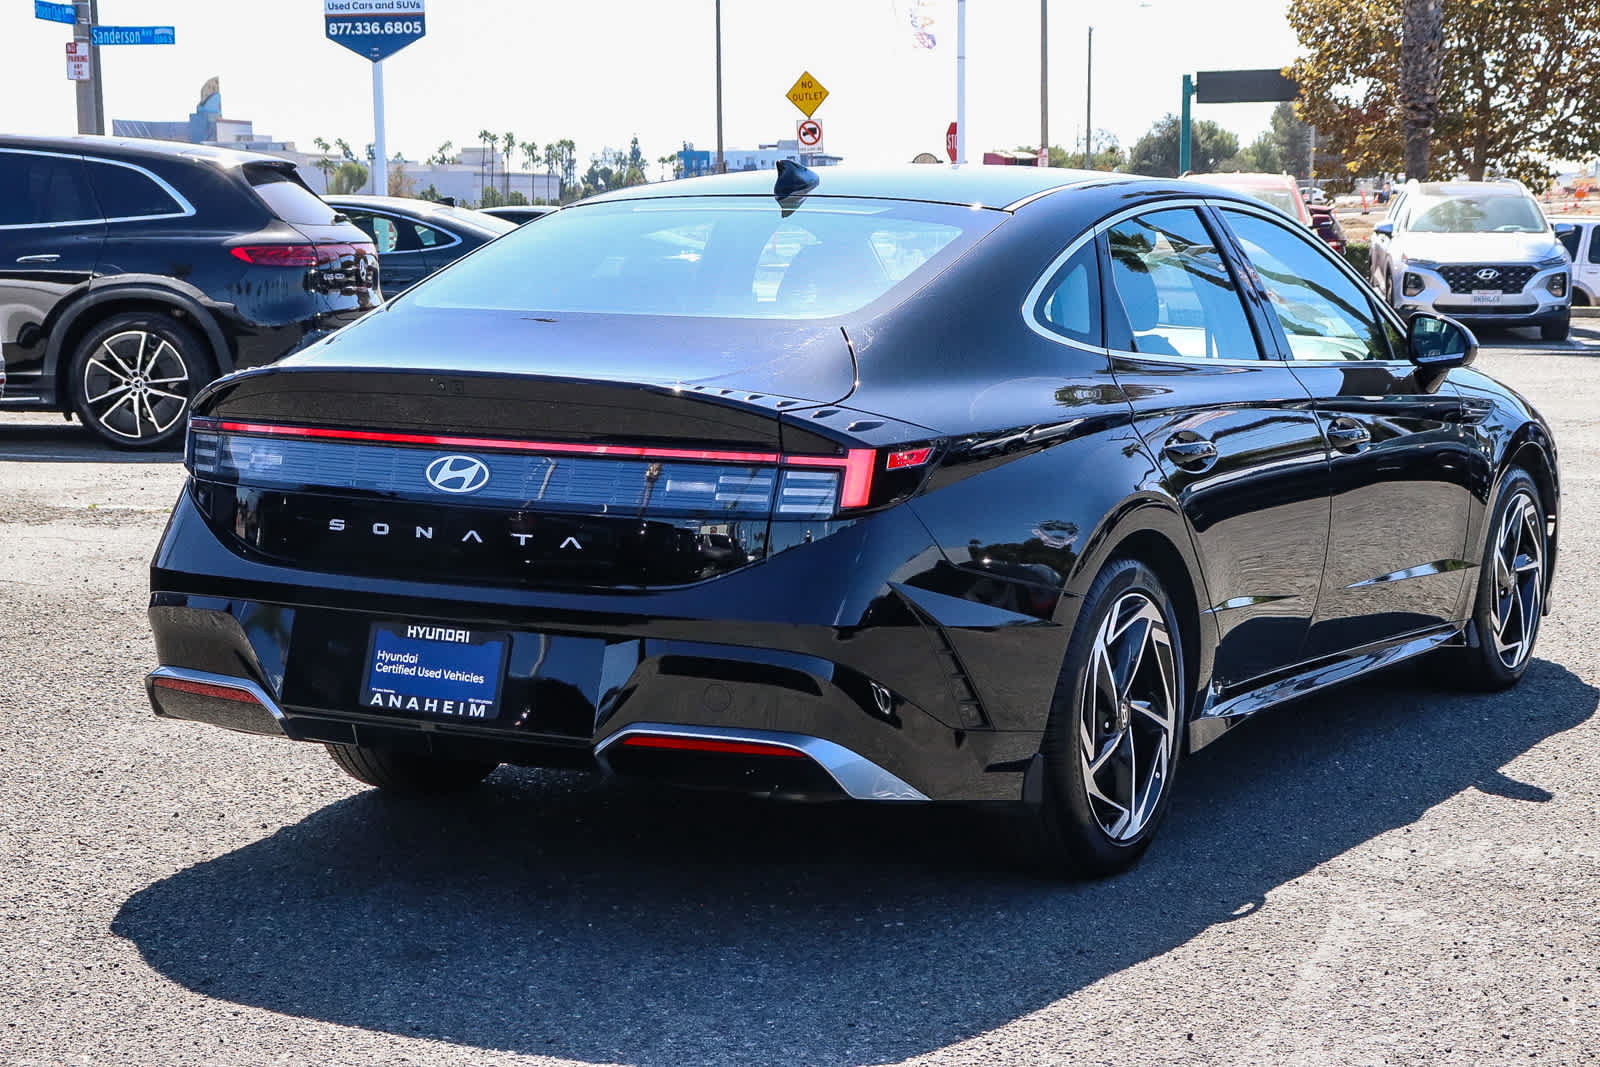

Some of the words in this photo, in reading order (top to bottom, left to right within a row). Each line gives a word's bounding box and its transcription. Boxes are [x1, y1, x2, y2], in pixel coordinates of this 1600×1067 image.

[328, 2, 351, 10] Used
[375, 1, 394, 9] and
[93, 29, 141, 43] Sanderson
[329, 22, 422, 35] 877.336.6805
[792, 92, 822, 101] OUTLET
[948, 134, 958, 150] STO
[328, 518, 582, 549] SONATA
[407, 625, 470, 643] HYUNDAI
[376, 650, 418, 664] Hyundai
[376, 663, 416, 676] Certified
[418, 668, 442, 679] Used
[444, 670, 484, 684] Vehicles
[370, 693, 486, 718] ANAHEIM
